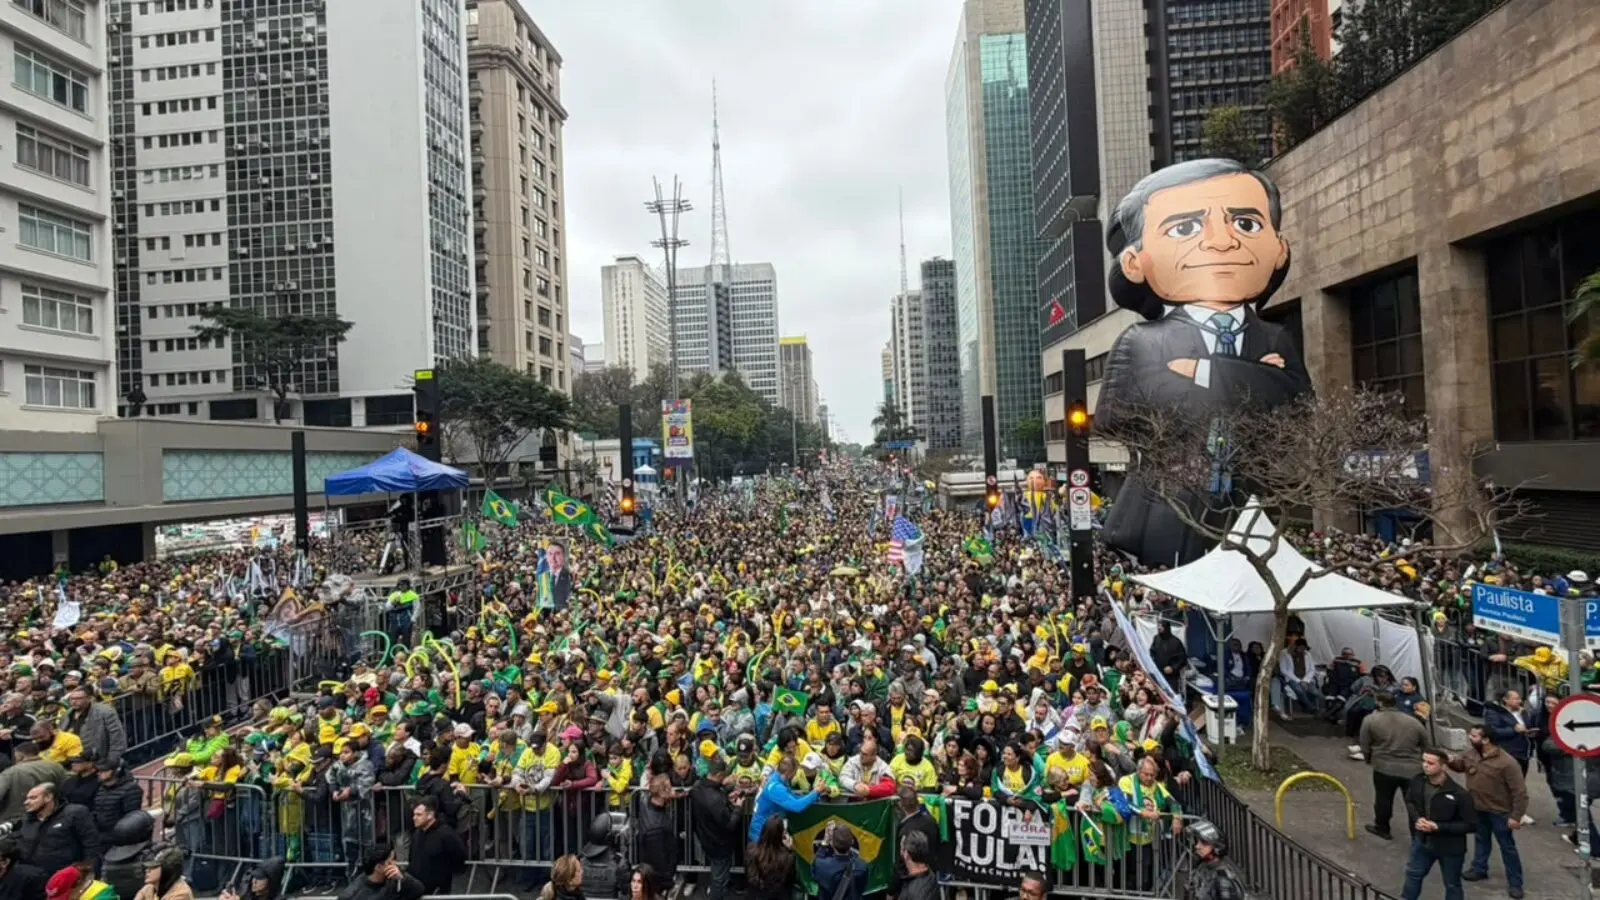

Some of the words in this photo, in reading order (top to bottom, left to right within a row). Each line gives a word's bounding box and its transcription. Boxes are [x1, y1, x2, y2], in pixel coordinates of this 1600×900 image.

[1073, 473, 1086, 482] 50
[1476, 586, 1535, 613] Paulista
[1012, 823, 1048, 835] FORA
[955, 830, 1046, 872] LULA!
[954, 859, 1027, 879] IMPEACHMEN
